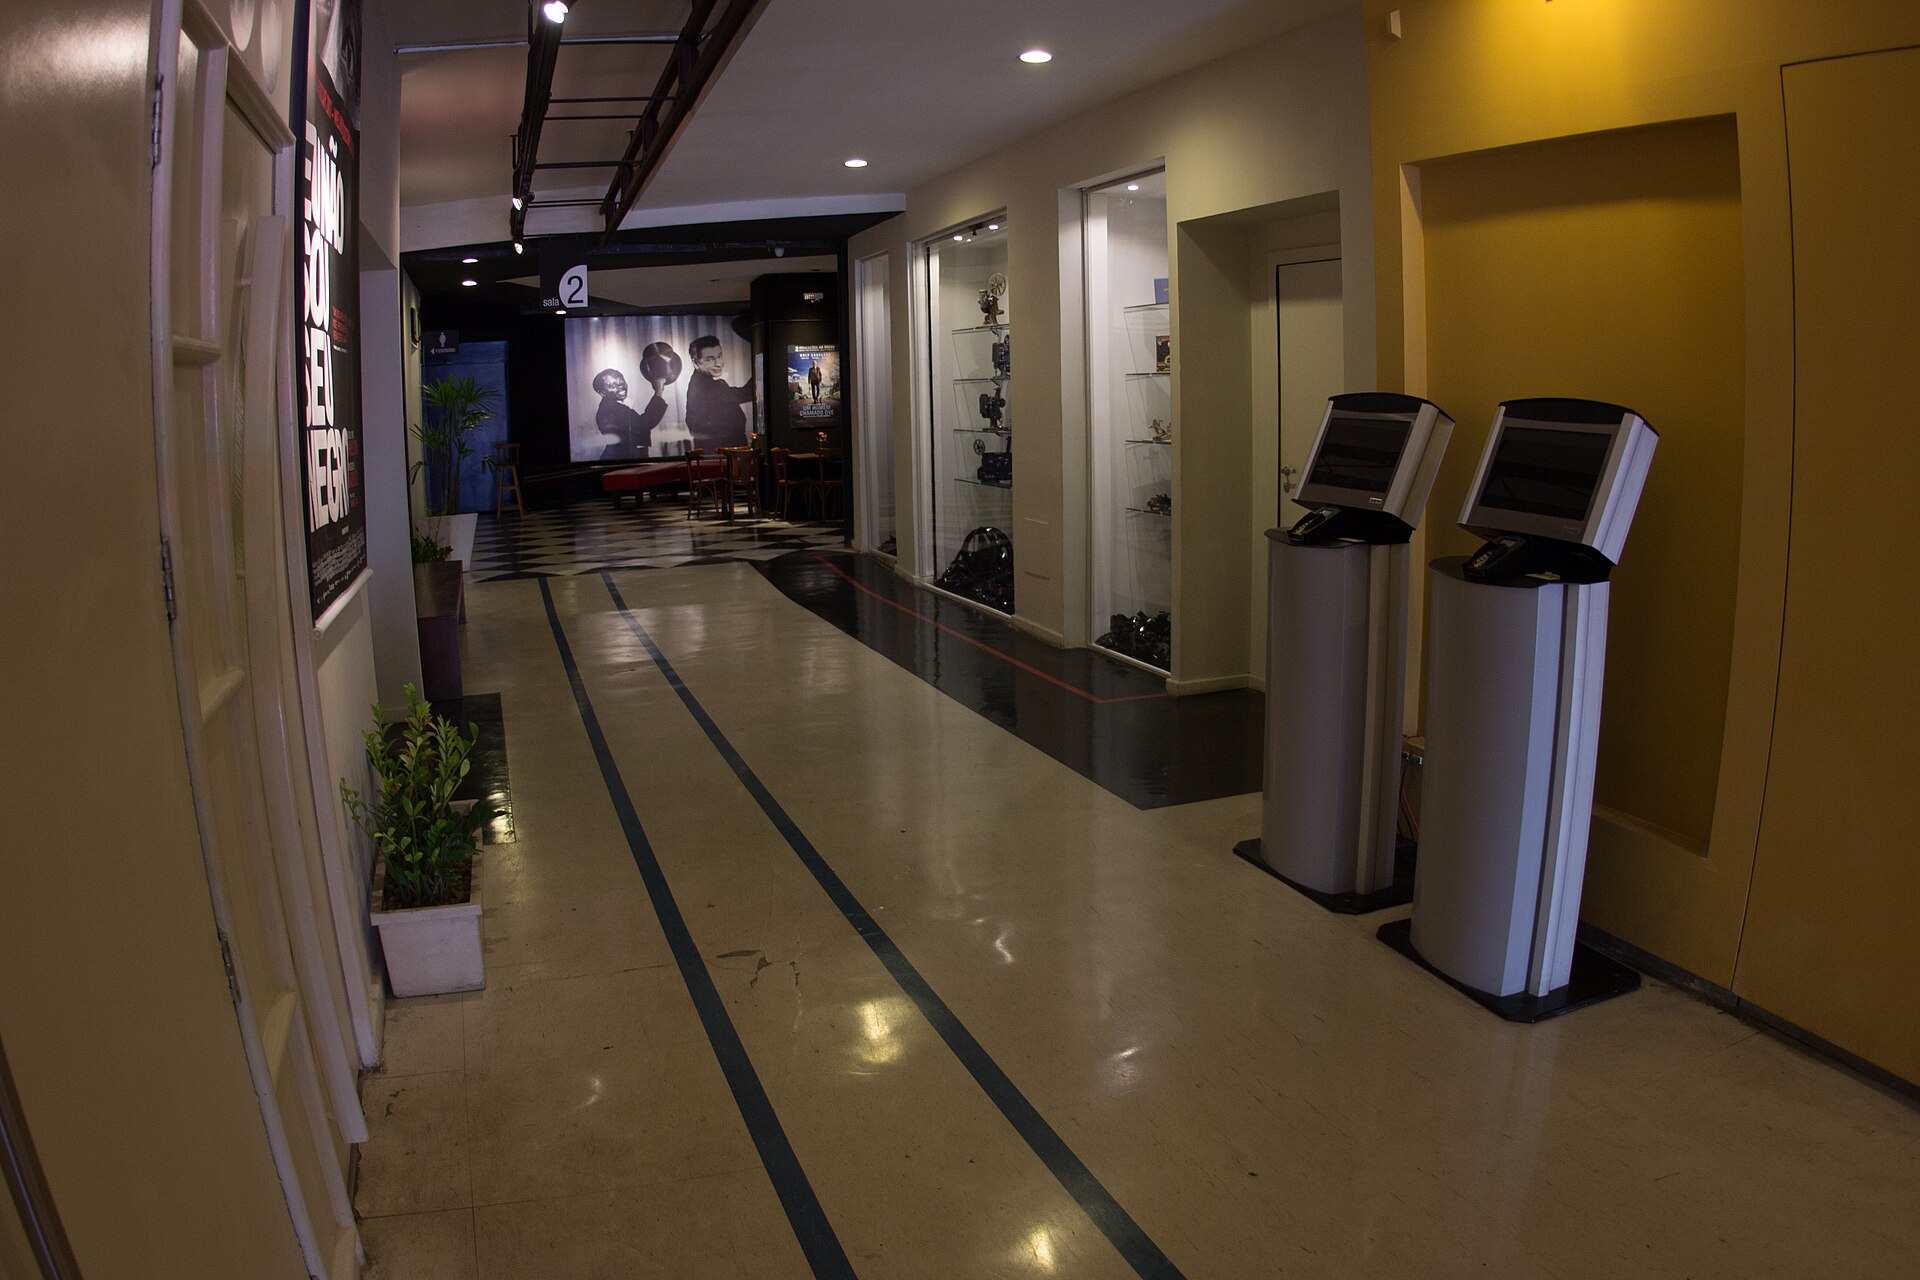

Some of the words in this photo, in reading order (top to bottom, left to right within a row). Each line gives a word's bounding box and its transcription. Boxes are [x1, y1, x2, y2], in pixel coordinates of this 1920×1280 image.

[320, 134, 344, 255] NÃO
[543, 297, 560, 307] sala
[567, 275, 584, 304] 2
[306, 428, 349, 534] NEGRO
